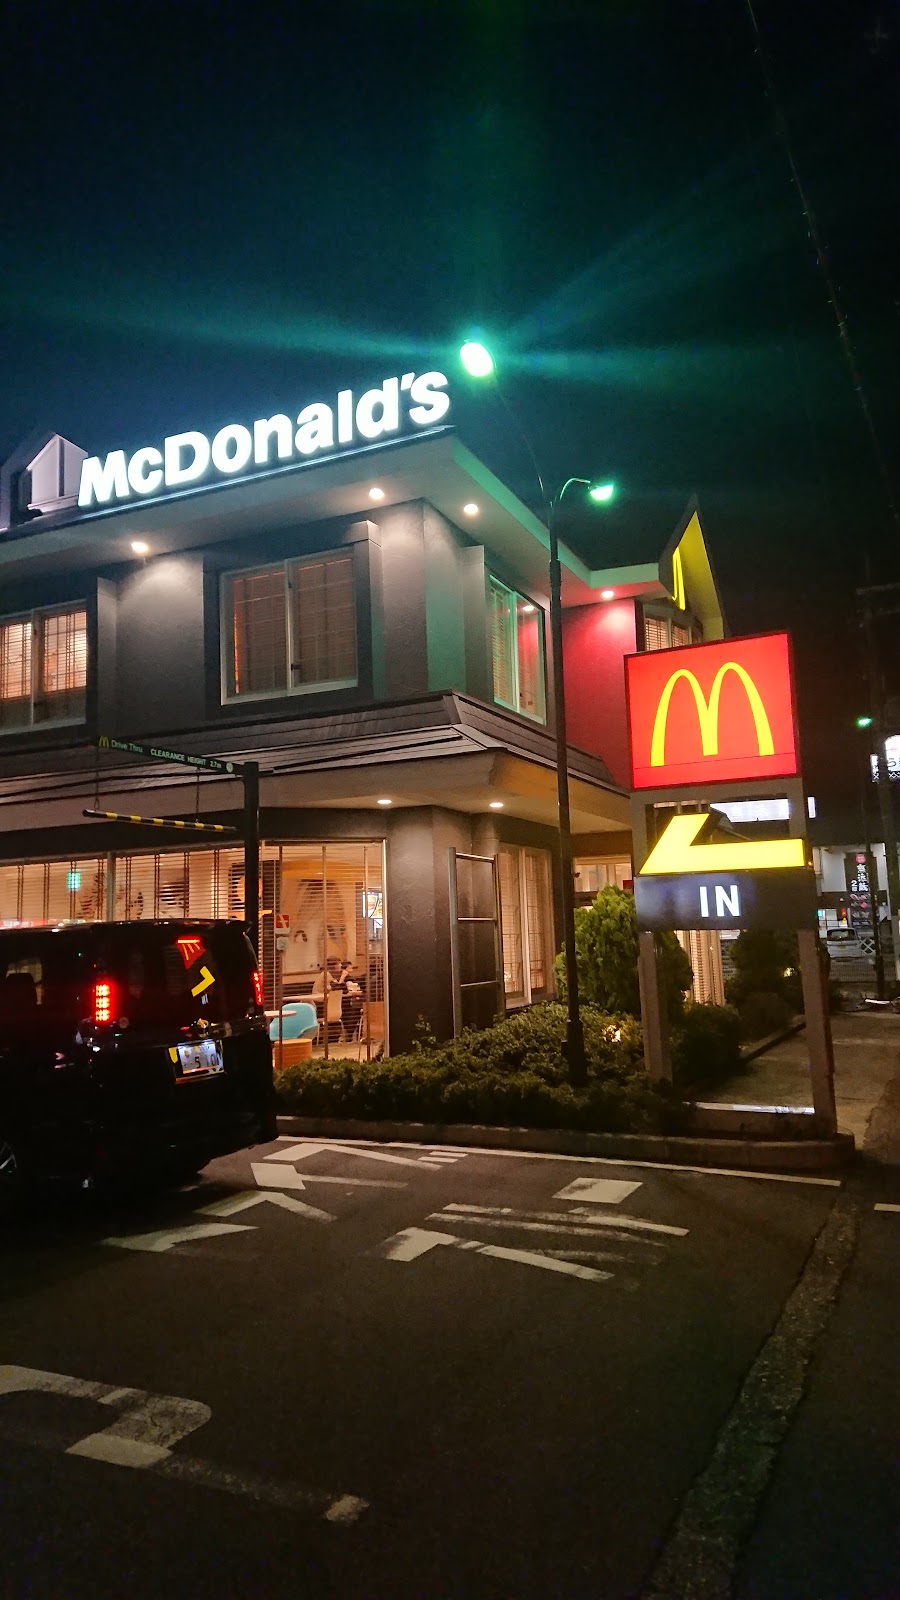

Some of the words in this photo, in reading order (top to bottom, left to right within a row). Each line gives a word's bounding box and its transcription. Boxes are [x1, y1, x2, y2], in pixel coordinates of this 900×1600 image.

[77, 371, 450, 507] McDonald's
[112, 740, 128, 750] Drive
[129, 744, 143, 753] Thru
[150, 748, 185, 761] CLEARANCE
[187, 756, 206, 766] HEIGHT
[699, 884, 741, 917] IN
